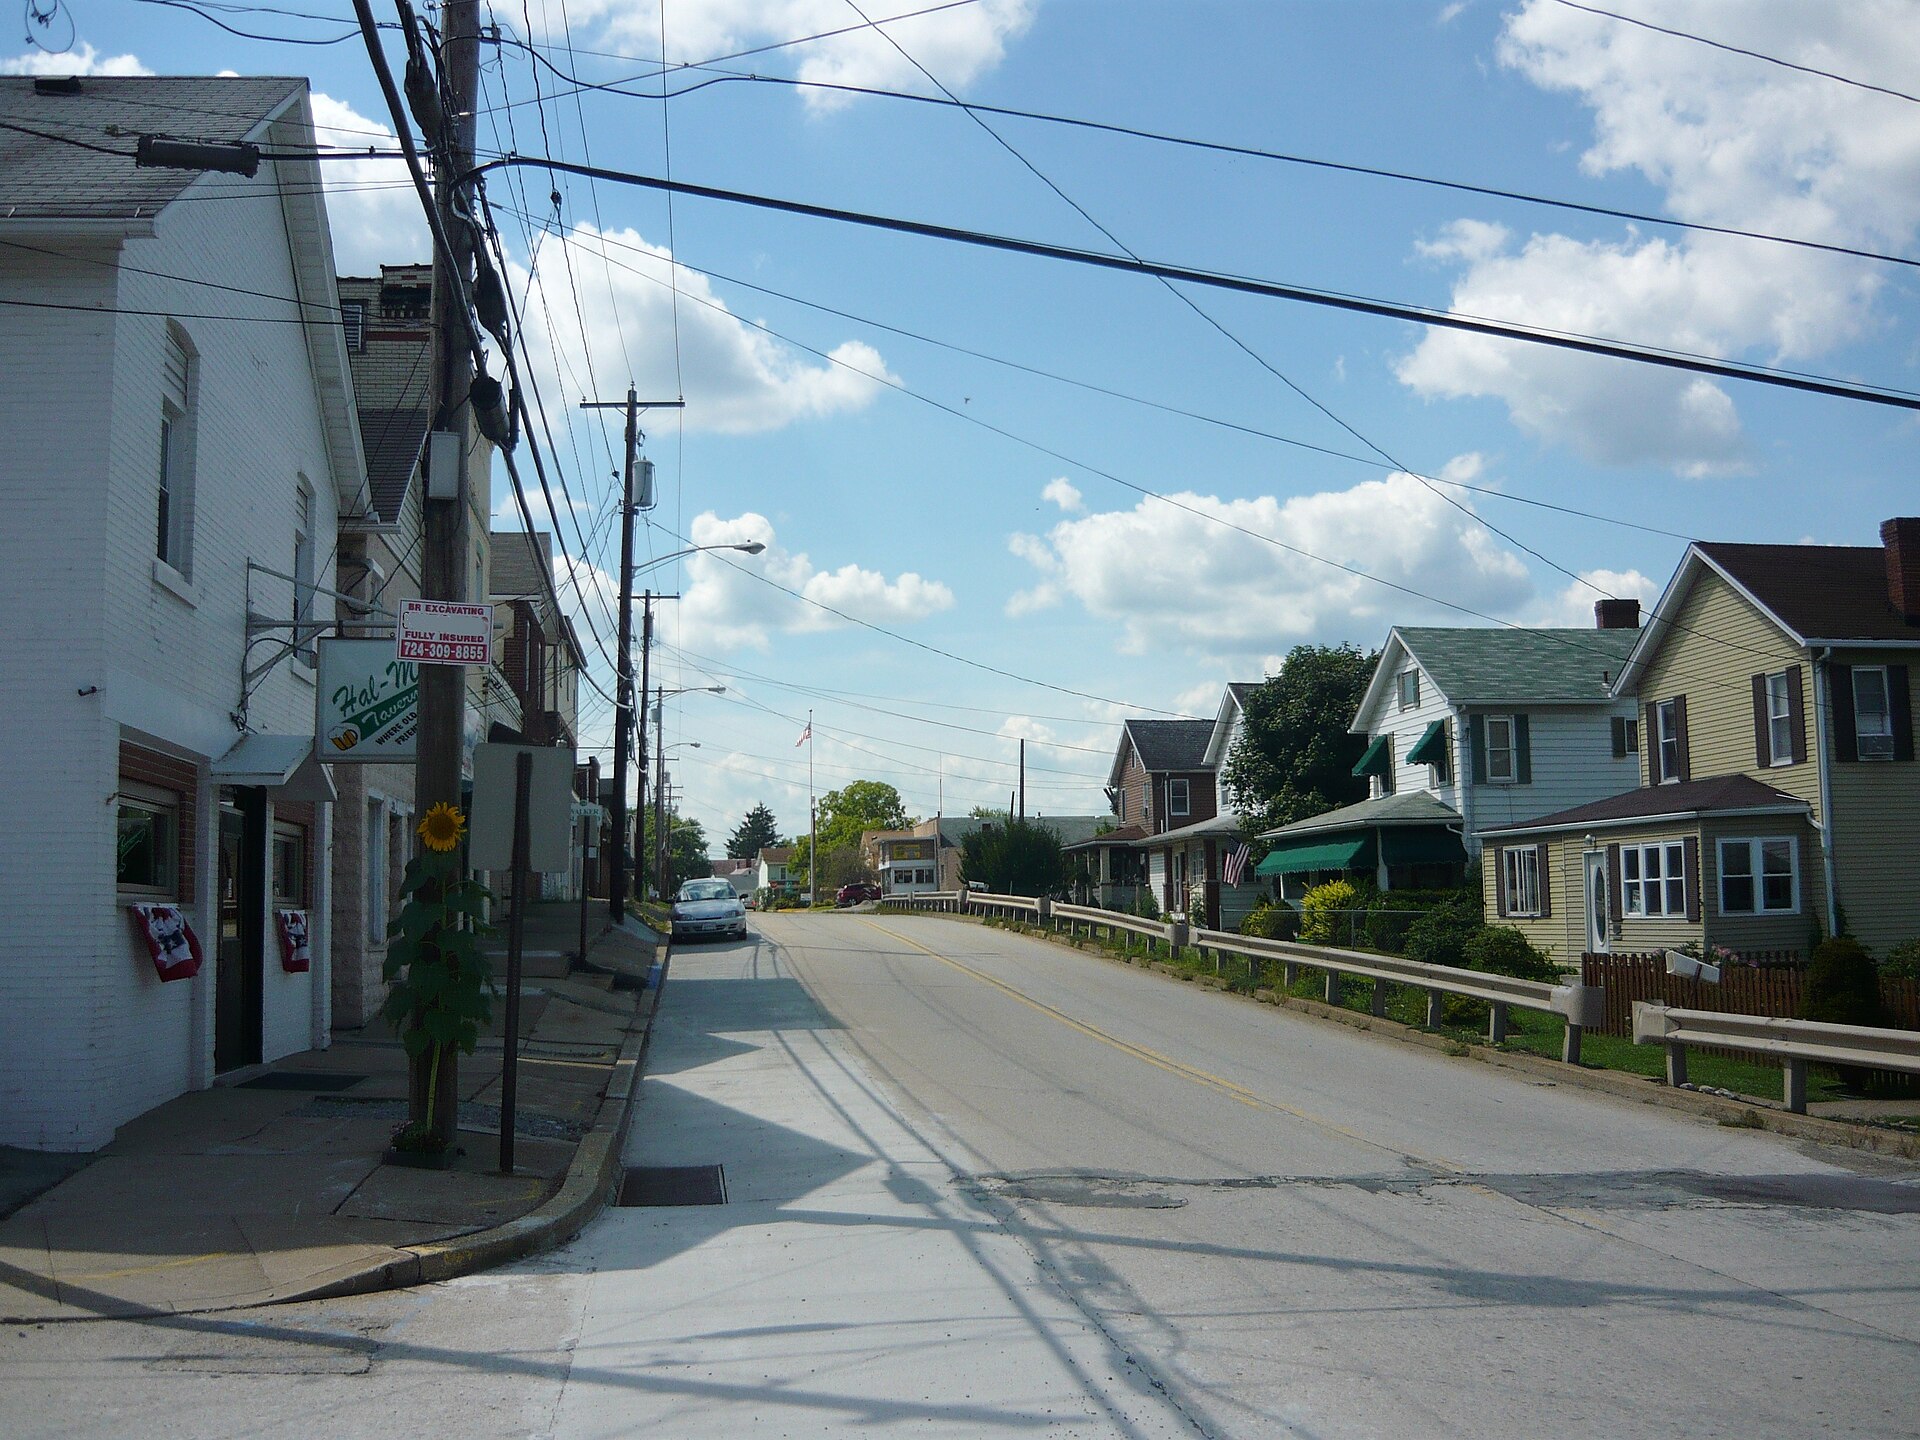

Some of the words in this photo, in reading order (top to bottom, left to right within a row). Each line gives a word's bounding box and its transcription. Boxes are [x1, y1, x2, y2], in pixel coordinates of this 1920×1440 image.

[408, 603, 421, 611] BR
[425, 604, 484, 615] EXCAVATING
[405, 631, 435, 640] FULLY
[440, 633, 484, 643] INSURED
[404, 641, 483, 660] 724-309-8855
[375, 722, 403, 746] WHERE
[402, 711, 418, 725] OLD
